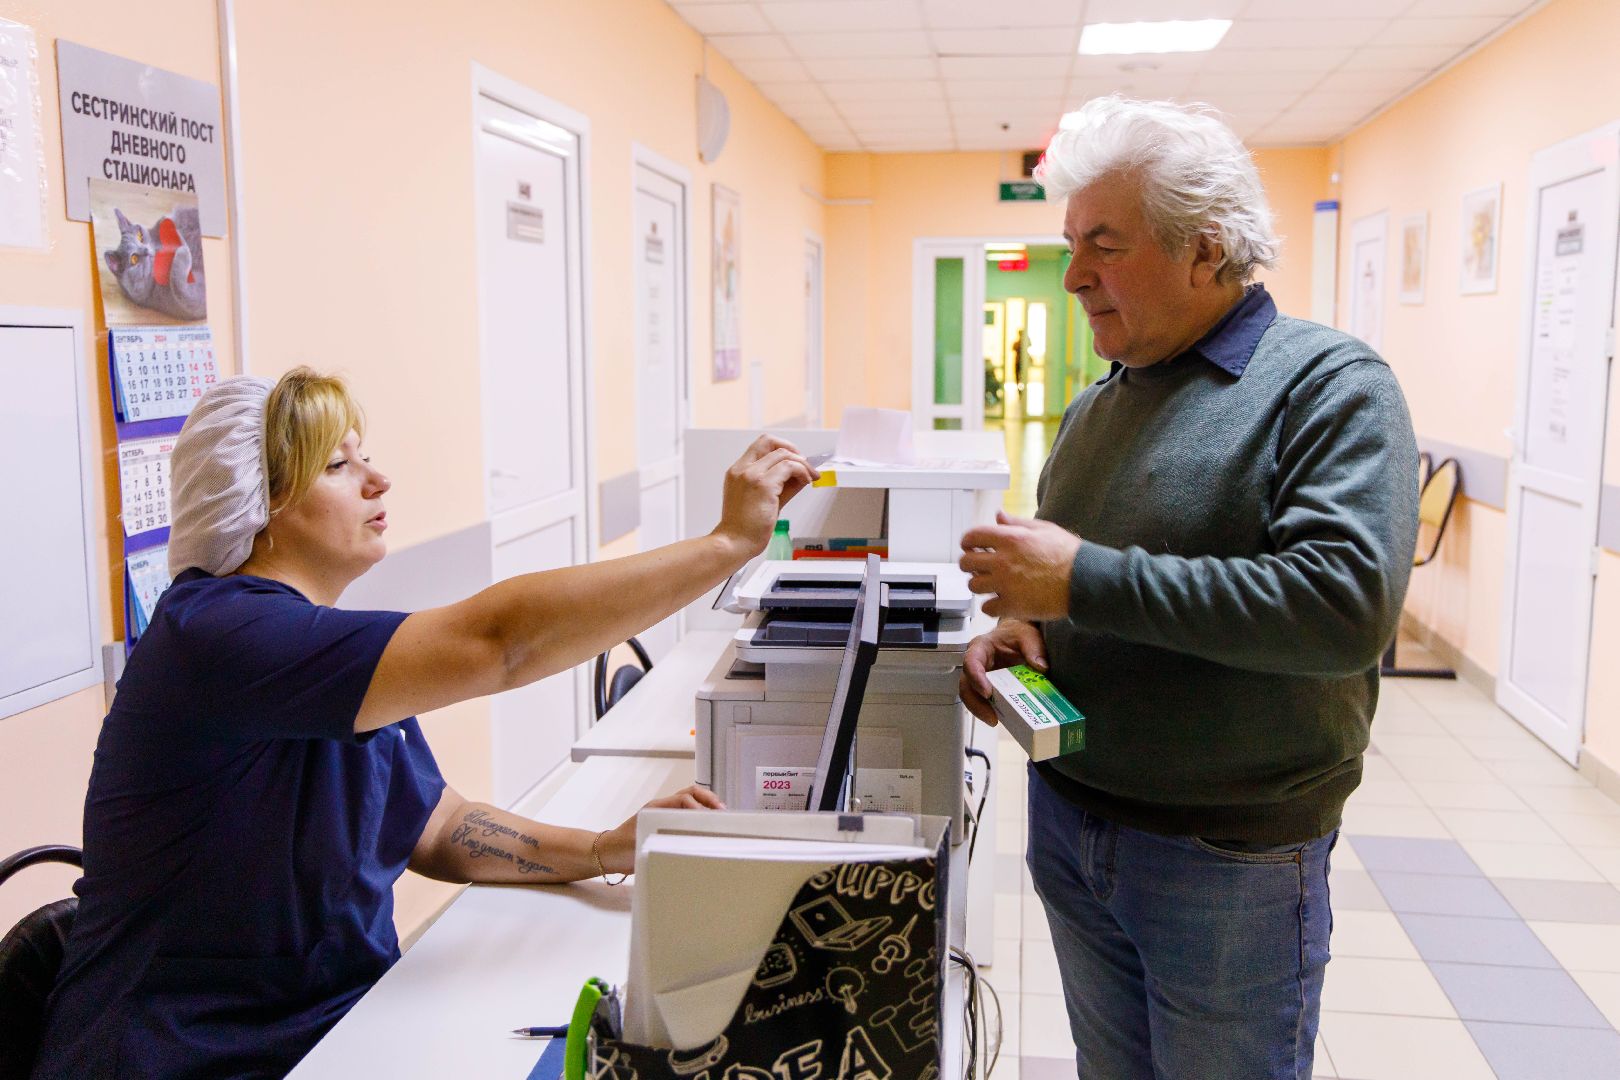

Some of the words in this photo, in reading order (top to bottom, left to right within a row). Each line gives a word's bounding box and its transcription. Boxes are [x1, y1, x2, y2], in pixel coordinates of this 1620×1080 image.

[71, 91, 177, 136] СЕСТРИНСКИЙ
[180, 118, 214, 144] ПОСТ
[111, 131, 186, 164] ДНЕВНОГО
[103, 158, 196, 193] СТАЦИОНАРА
[126, 352, 131, 363] 2
[139, 352, 144, 362] 3
[151, 352, 156, 360] 4
[164, 351, 169, 360] 5
[176, 350, 181, 360] 6
[189, 350, 194, 359] 7
[128, 366, 133, 376] 9
[138, 365, 148, 375] 10
[152, 365, 160, 374] 11
[163, 364, 172, 374] 12
[176, 363, 185, 373] 13
[189, 362, 199, 371] 14
[203, 361, 214, 371] 15
[128, 380, 136, 390] 16
[140, 379, 149, 389] 17
[165, 377, 173, 387] 19
[177, 376, 186, 386] 20
[204, 374, 216, 383] 22
[129, 393, 138, 404] 23
[140, 392, 151, 402] 24
[154, 391, 162, 401] 25
[165, 390, 175, 400] 26
[177, 389, 187, 399] 27
[145, 464, 149, 473] 1
[157, 462, 161, 472] 2
[145, 477, 149, 487] 8
[157, 475, 162, 485] 9
[134, 492, 141, 503] 14
[144, 490, 152, 500] 15
[156, 488, 165, 498] 16
[134, 506, 142, 516] 21
[145, 504, 153, 514] 22
[146, 517, 154, 527] 29
[158, 513, 167, 524] 30
[763, 780, 791, 789] 2023
[450, 823, 479, 850] Кто
[743, 986, 824, 1025] business
